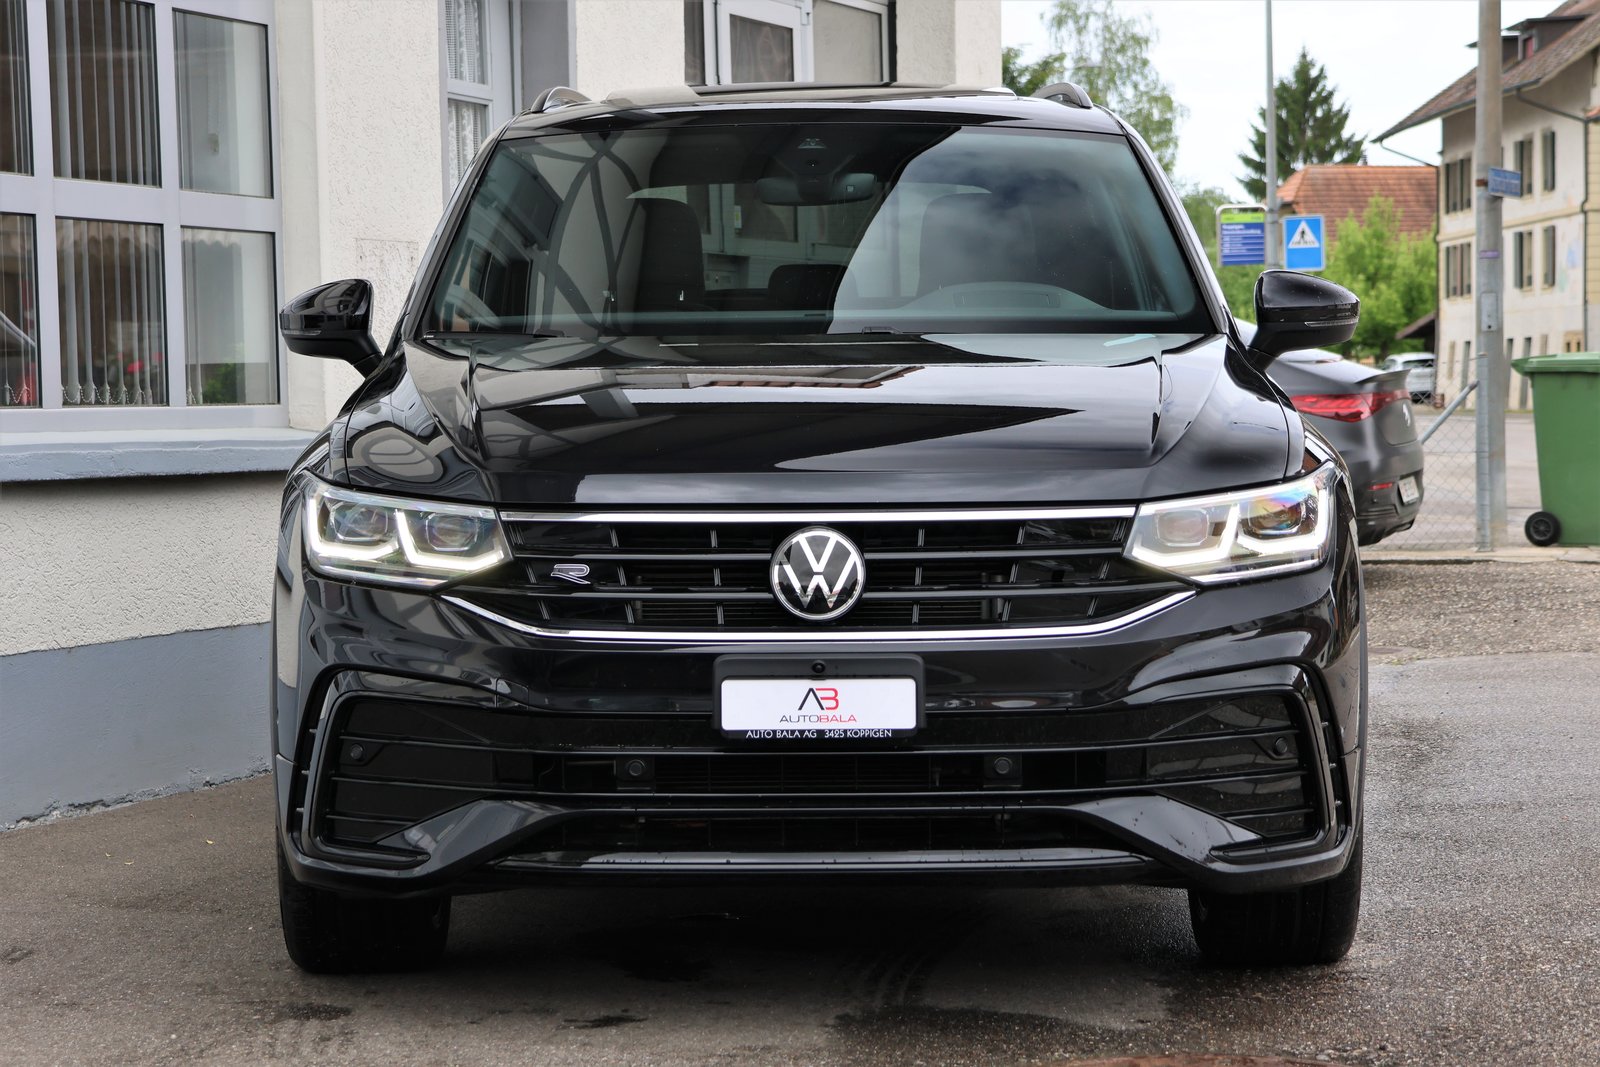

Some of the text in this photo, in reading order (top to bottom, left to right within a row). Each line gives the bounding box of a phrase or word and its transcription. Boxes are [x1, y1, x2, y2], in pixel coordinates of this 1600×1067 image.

[797, 687, 839, 711] AB
[779, 714, 857, 723] AUTOBALA
[745, 729, 892, 738] AUTO BALA AG 3425 KOPPIGEN
